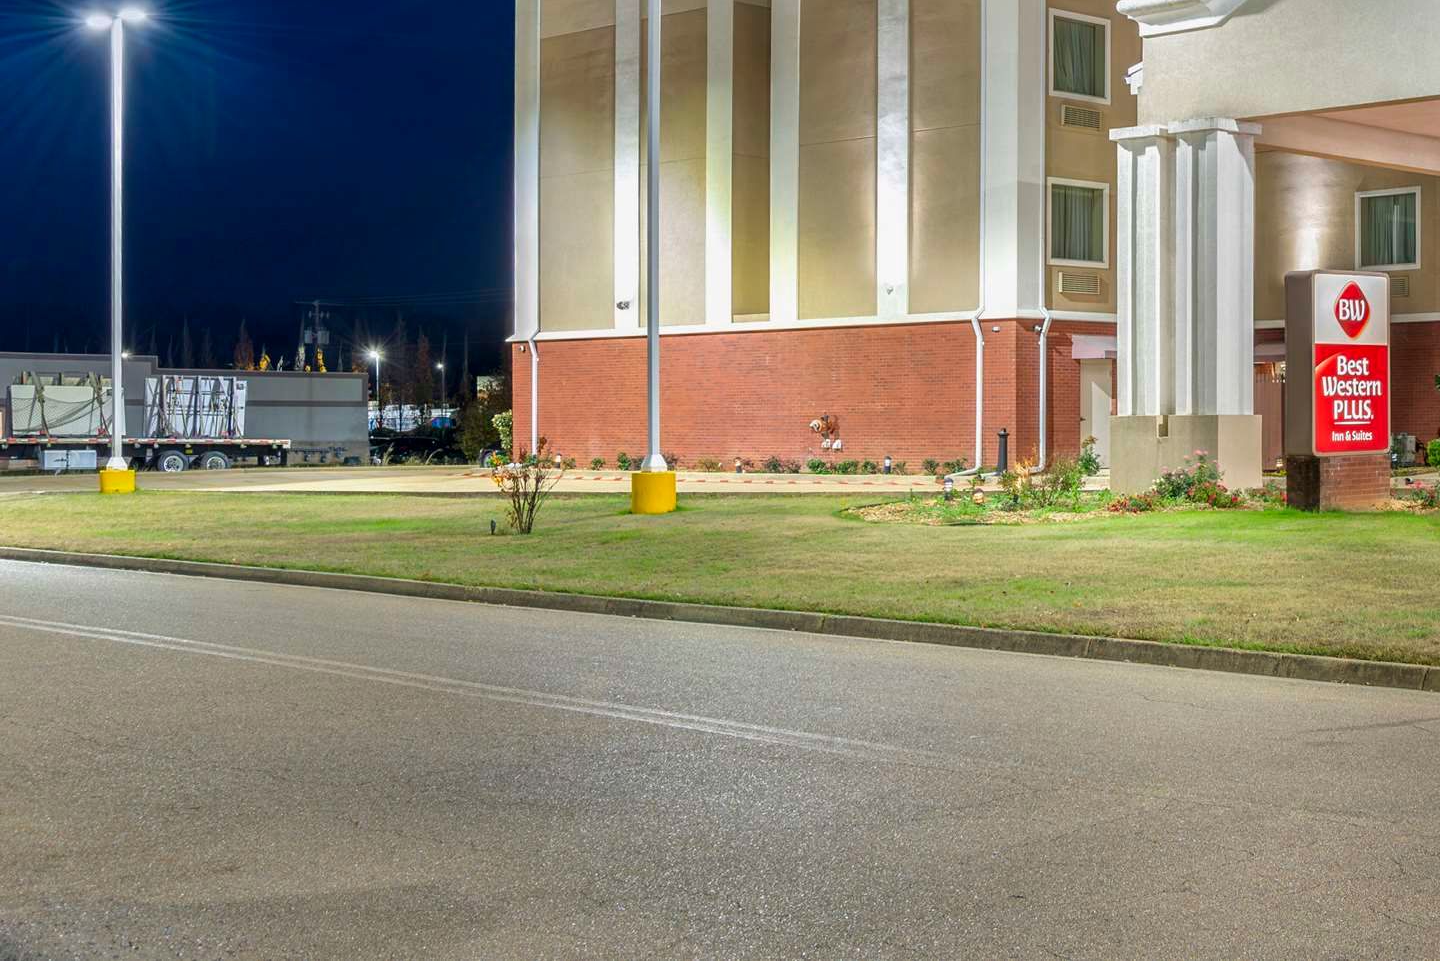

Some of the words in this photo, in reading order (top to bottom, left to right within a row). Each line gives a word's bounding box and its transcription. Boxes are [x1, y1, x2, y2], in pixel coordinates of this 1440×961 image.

[1339, 299, 1365, 321] BW
[1337, 355, 1369, 376] Best
[1322, 376, 1382, 396] Western
[1332, 431, 1344, 441] Inn
[1345, 431, 1351, 441] &
[1352, 430, 1373, 441] Suites
